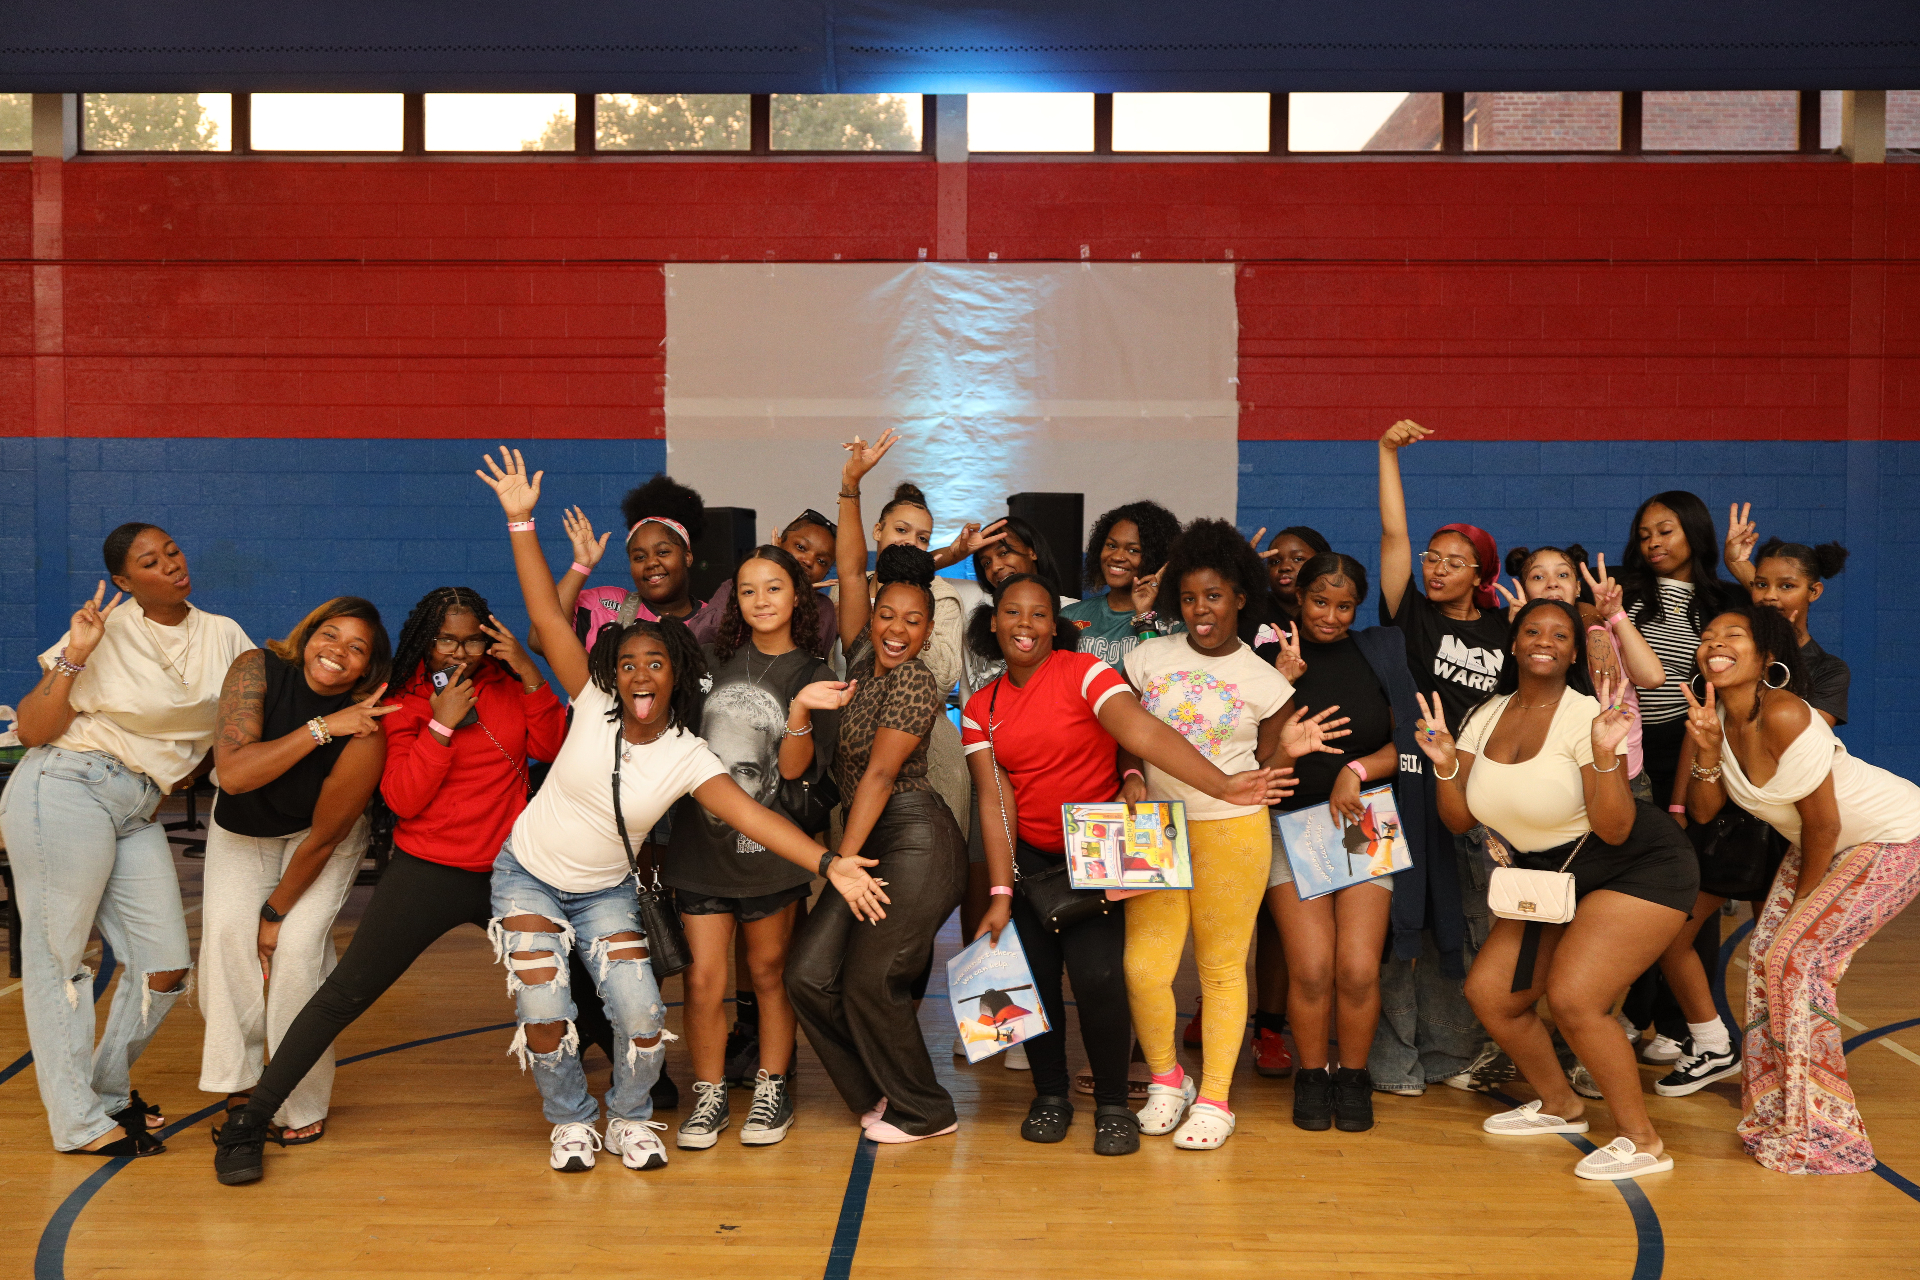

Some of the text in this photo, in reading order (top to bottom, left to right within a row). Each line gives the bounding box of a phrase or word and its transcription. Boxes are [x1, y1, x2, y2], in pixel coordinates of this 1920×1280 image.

[602, 600, 617, 609] ELLO
[1436, 634, 1504, 676] MEN
[1305, 840, 1317, 855] get
[1319, 843, 1328, 859] can
[1312, 856, 1322, 871] can
[1326, 859, 1335, 873] We
[977, 952, 991, 964] get
[961, 974, 974, 985] We
[974, 966, 989, 976] can
